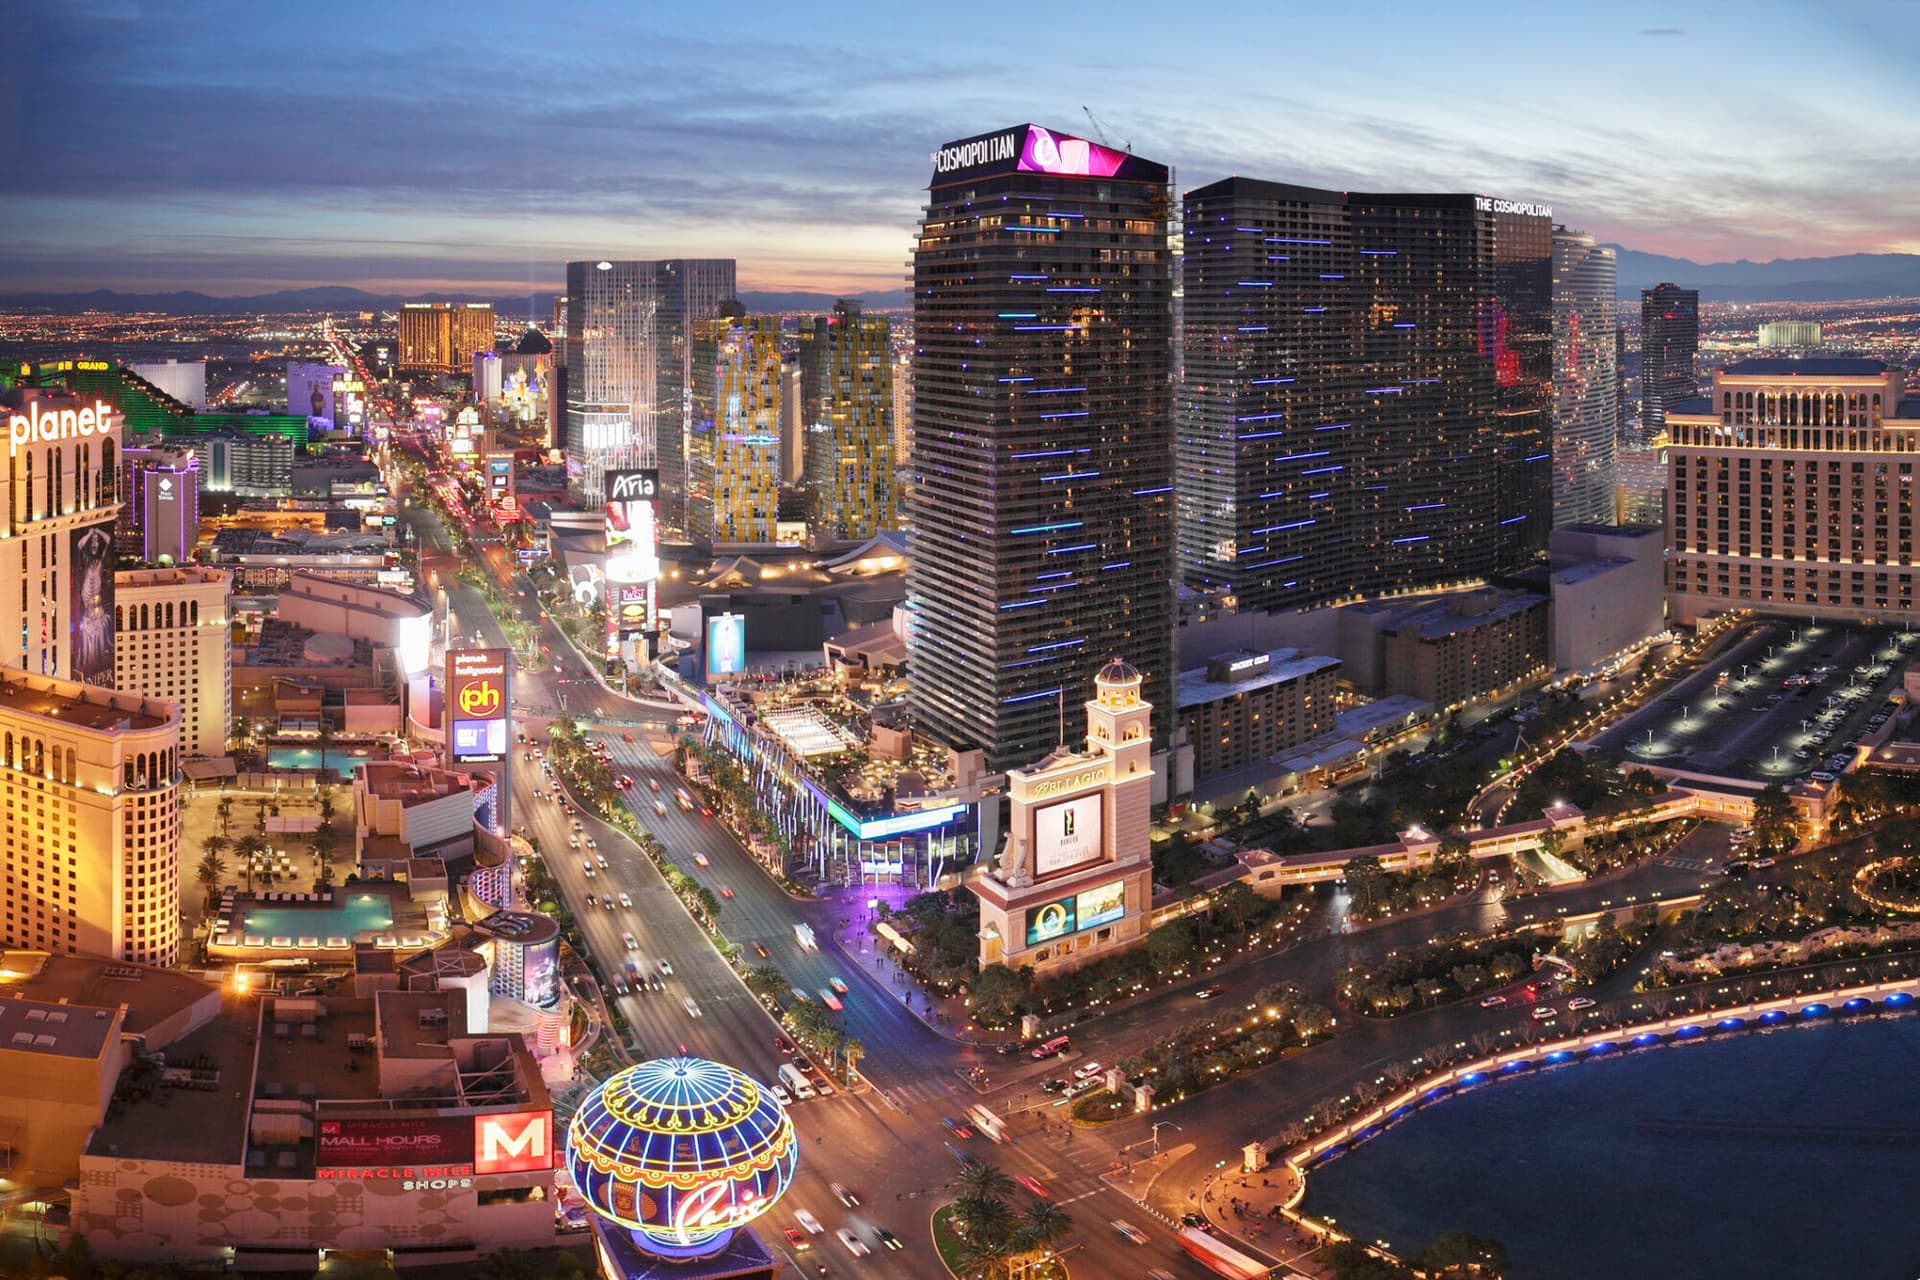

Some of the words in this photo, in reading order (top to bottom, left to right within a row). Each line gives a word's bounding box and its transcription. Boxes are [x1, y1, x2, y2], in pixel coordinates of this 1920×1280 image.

[937, 133, 1015, 173] COSMOPOLITAN
[1475, 197, 1493, 211] THE
[1494, 199, 1552, 217] COSMOPOLITAN
[77, 361, 109, 370] GRAND
[9, 399, 111, 457] planet
[612, 473, 654, 498] Aria
[455, 653, 488, 665] planet
[455, 665, 503, 676] hollywood
[463, 681, 500, 713] ph
[1034, 769, 1105, 796] BELLAGIO
[321, 1137, 371, 1146] MALL
[376, 1134, 441, 1146] HOURS
[483, 1117, 545, 1161] M
[317, 1168, 414, 1179] MIRACLE
[424, 1165, 471, 1177] MILE
[402, 1178, 472, 1191] SHOPS
[675, 1180, 774, 1246] Paris
